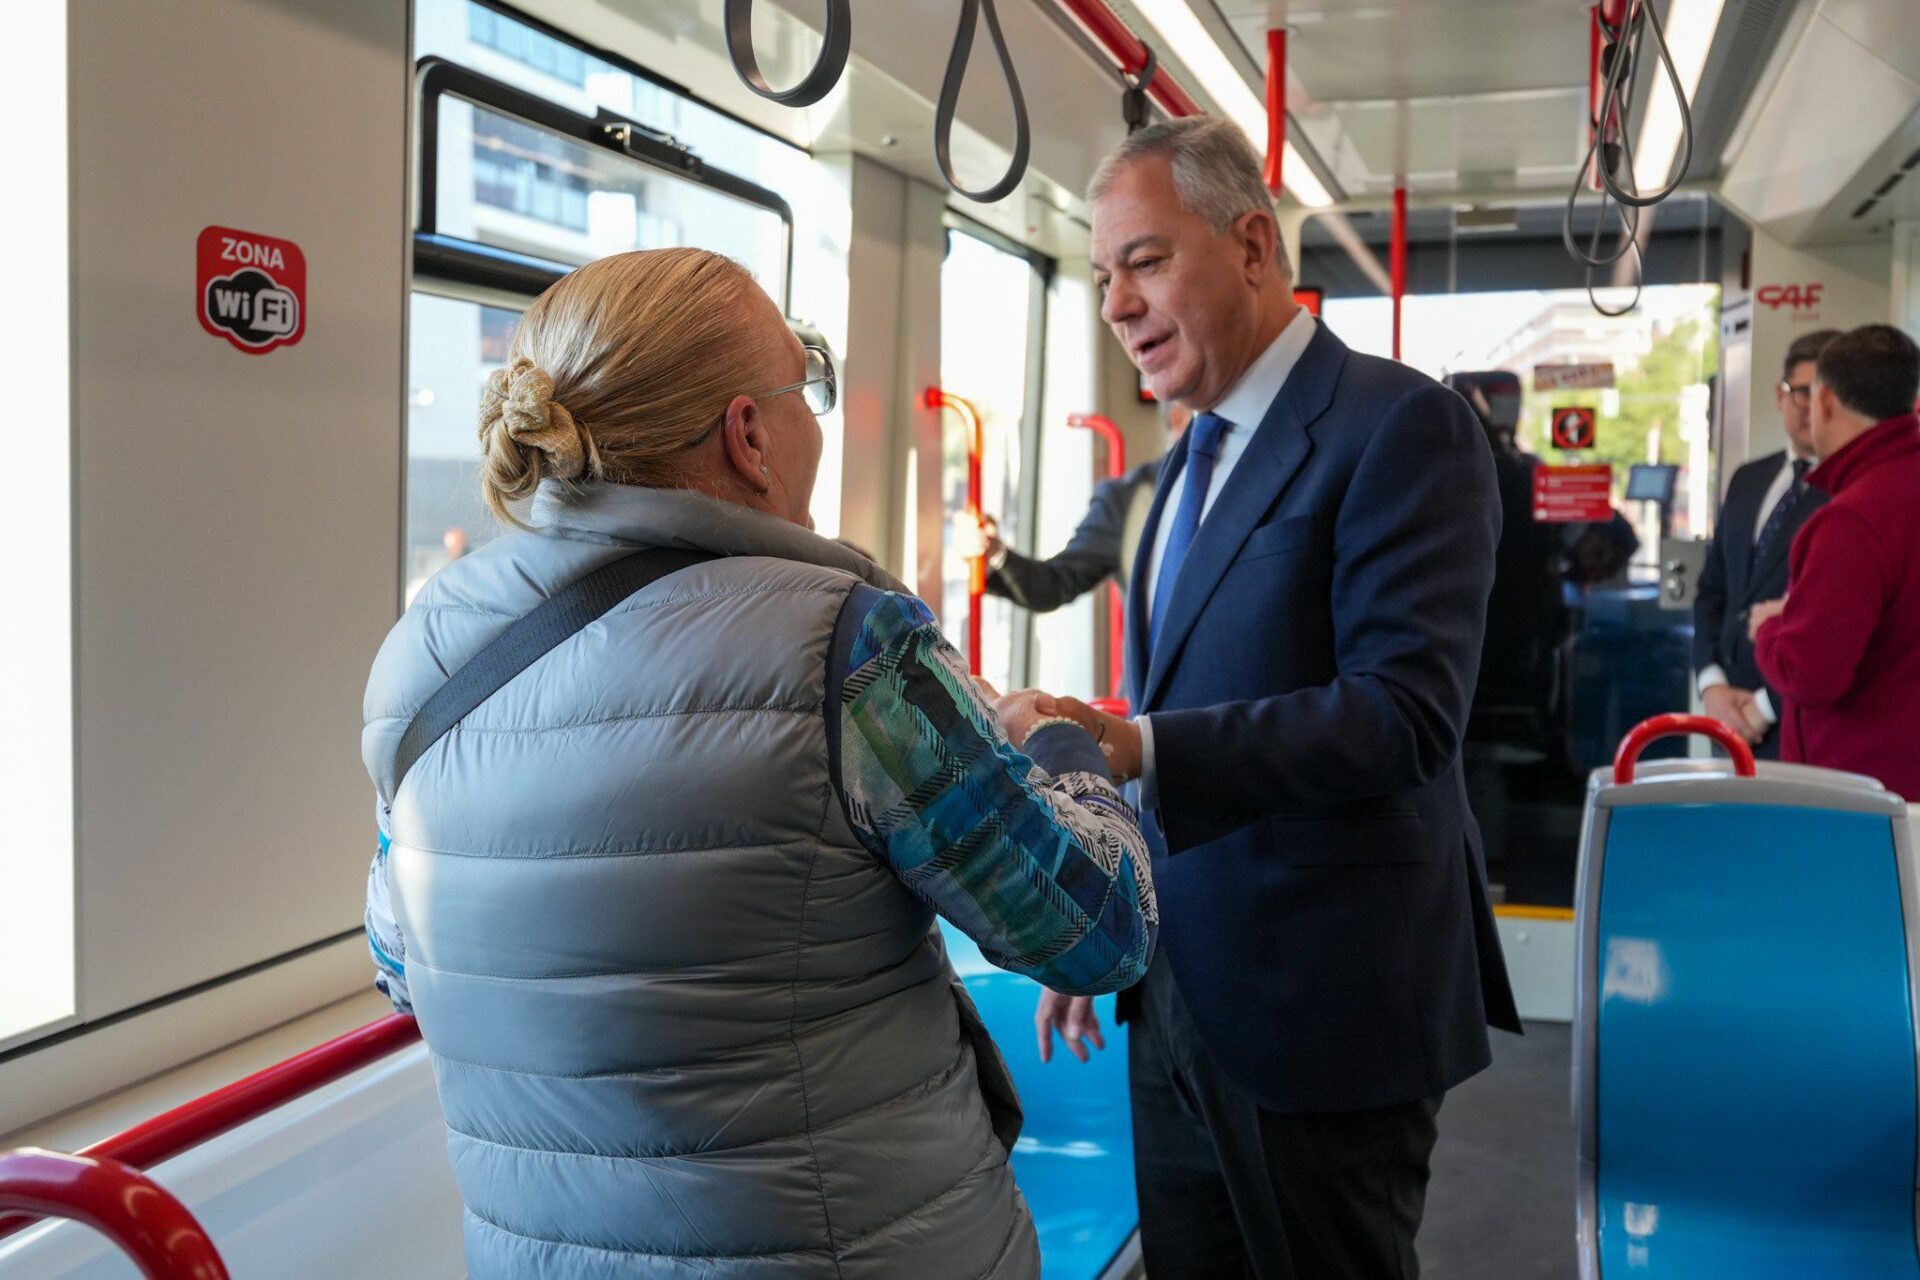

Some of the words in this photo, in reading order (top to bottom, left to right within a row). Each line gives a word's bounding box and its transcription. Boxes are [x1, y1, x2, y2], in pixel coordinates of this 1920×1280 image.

[221, 237, 285, 270] ZONA
[215, 288, 288, 325] WiFi
[1757, 283, 1824, 311] CAF
